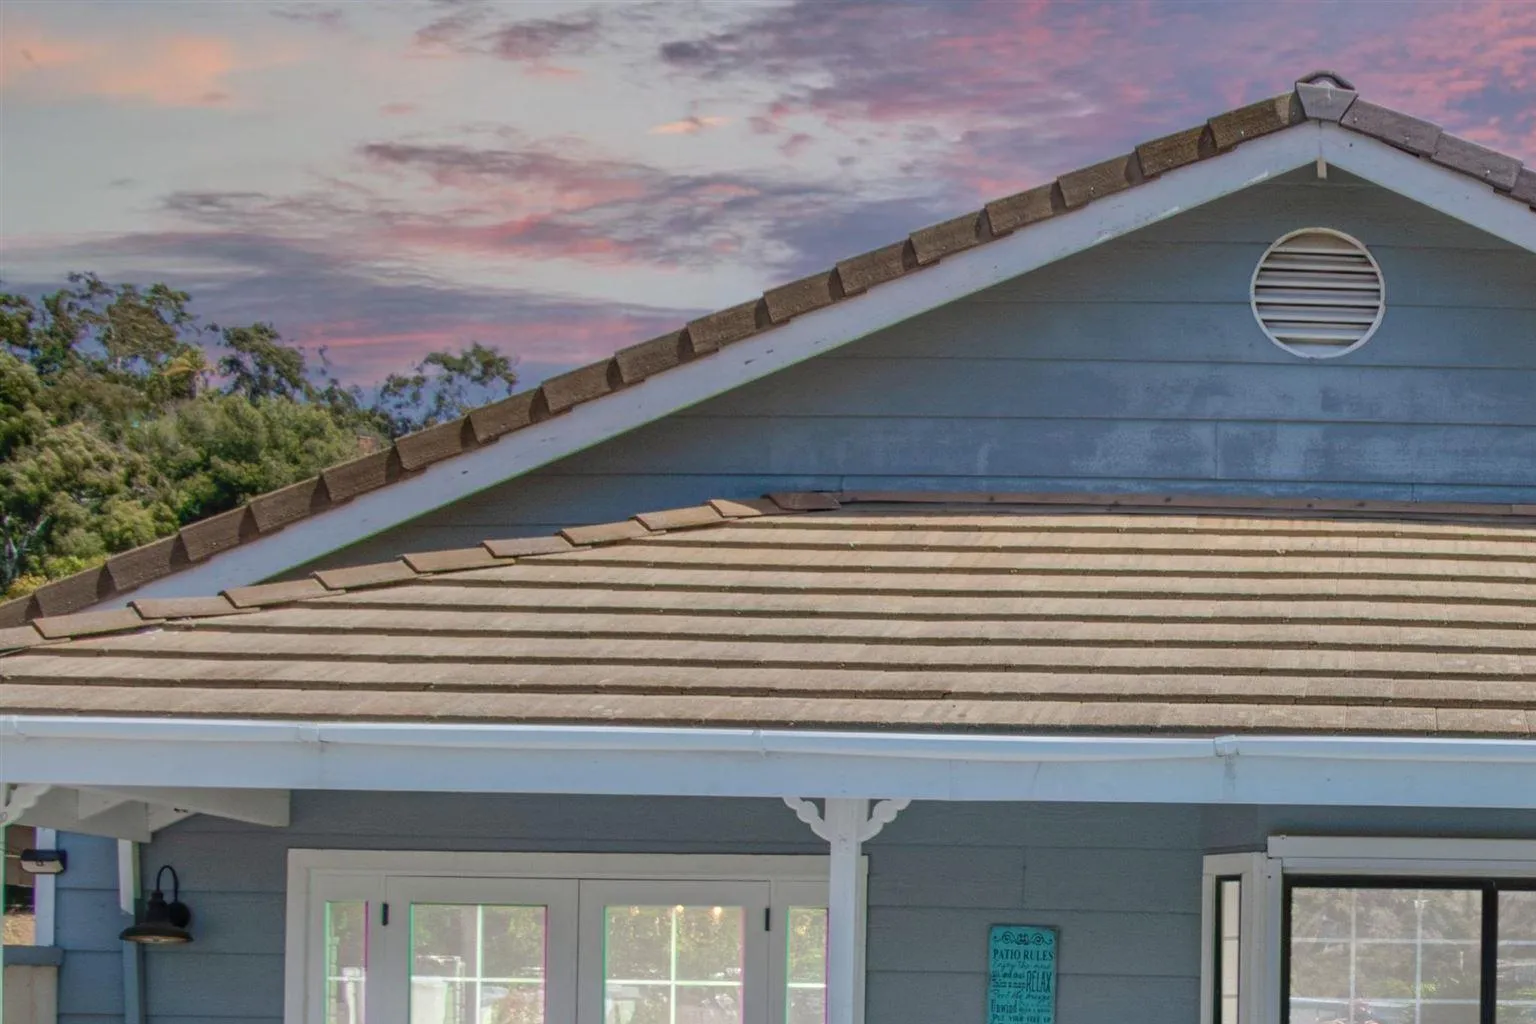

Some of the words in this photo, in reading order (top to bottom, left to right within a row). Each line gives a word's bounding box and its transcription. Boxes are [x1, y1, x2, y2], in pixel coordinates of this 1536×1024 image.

[993, 948, 1021, 960] PATIO
[1023, 949, 1055, 961] RULES
[1026, 970, 1052, 993] RELAX
